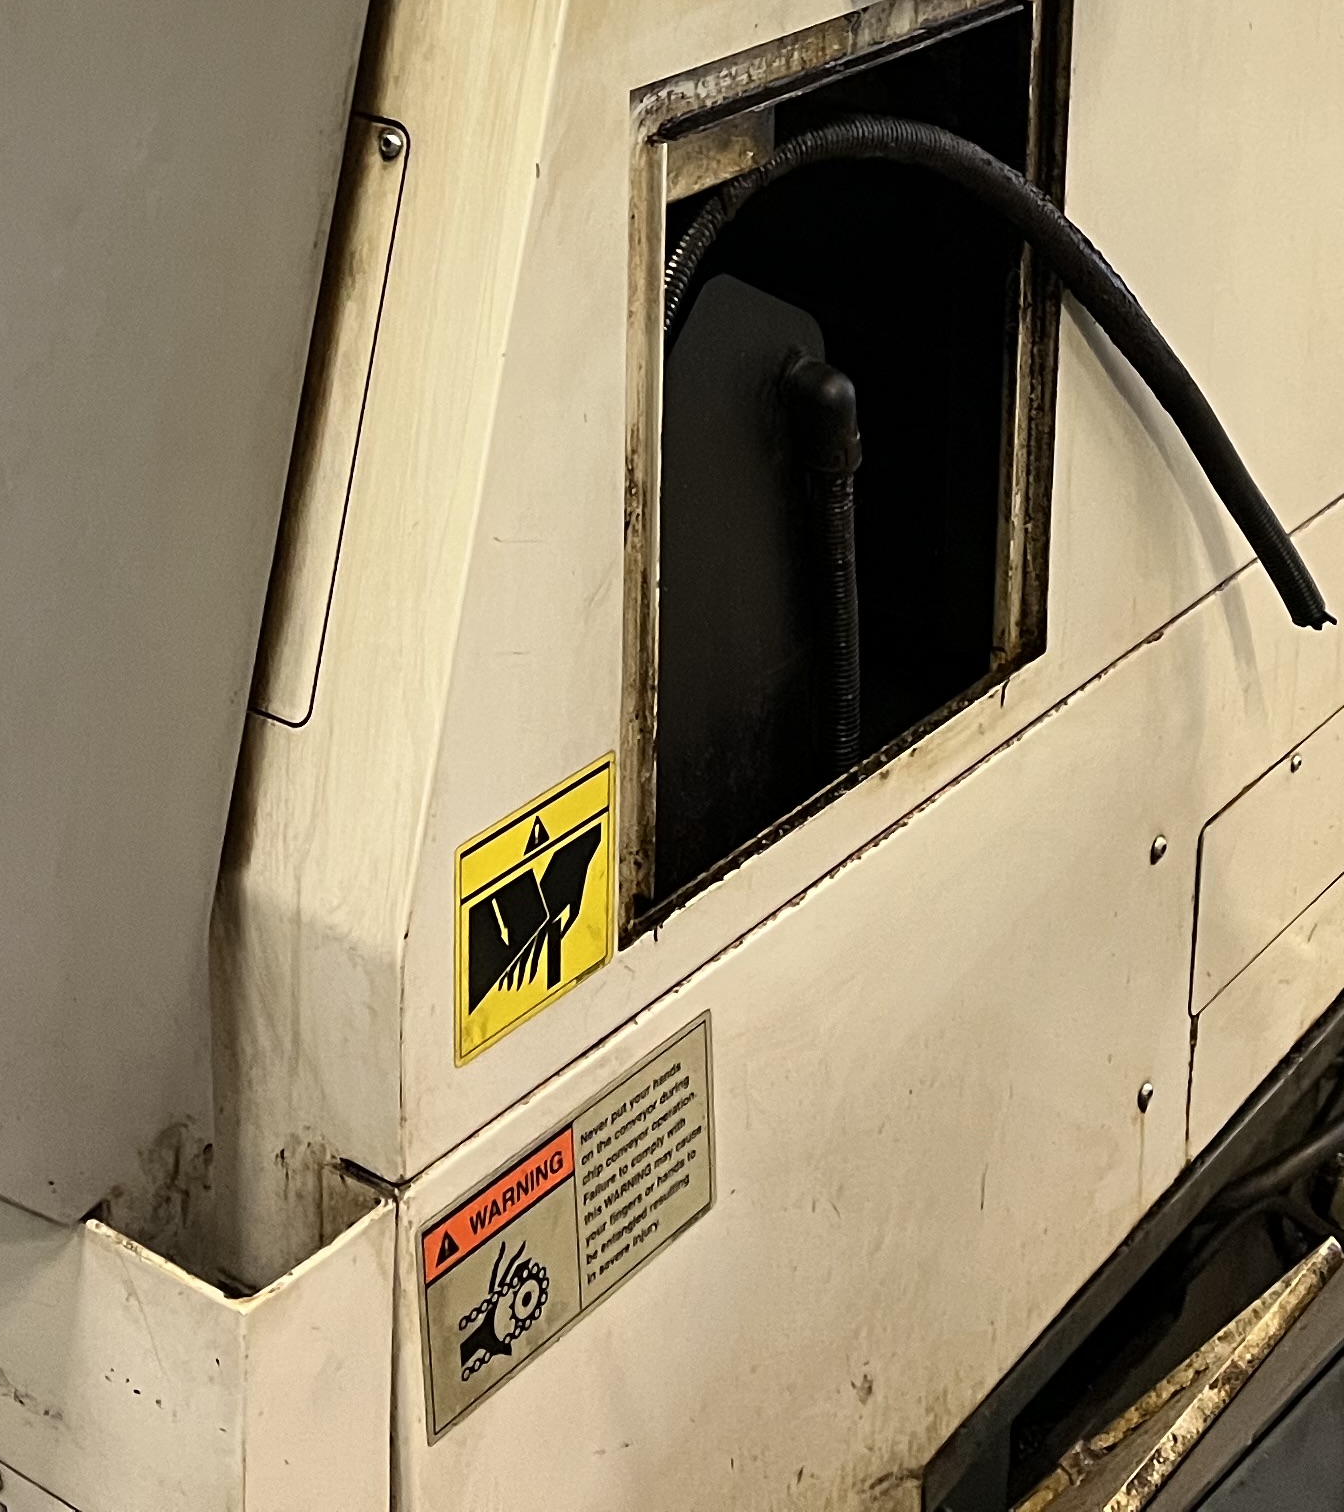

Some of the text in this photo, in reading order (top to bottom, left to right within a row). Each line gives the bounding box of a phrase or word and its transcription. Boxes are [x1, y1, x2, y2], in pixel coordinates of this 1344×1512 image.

[580, 1062, 681, 1145] Never put your hands
[581, 1076, 690, 1165] on the conveyor during
[469, 1151, 563, 1235] WARNING
[582, 1164, 604, 1186] chip
[606, 1126, 649, 1167] conveyor
[583, 1118, 686, 1206] Failure to comply with
[584, 1125, 702, 1225] this WARNING may cause
[586, 1150, 697, 1248] your fingers or hands to
[587, 1174, 690, 1265] be entangled resulting
[587, 1272, 597, 1286] in
[599, 1244, 631, 1276] severe
